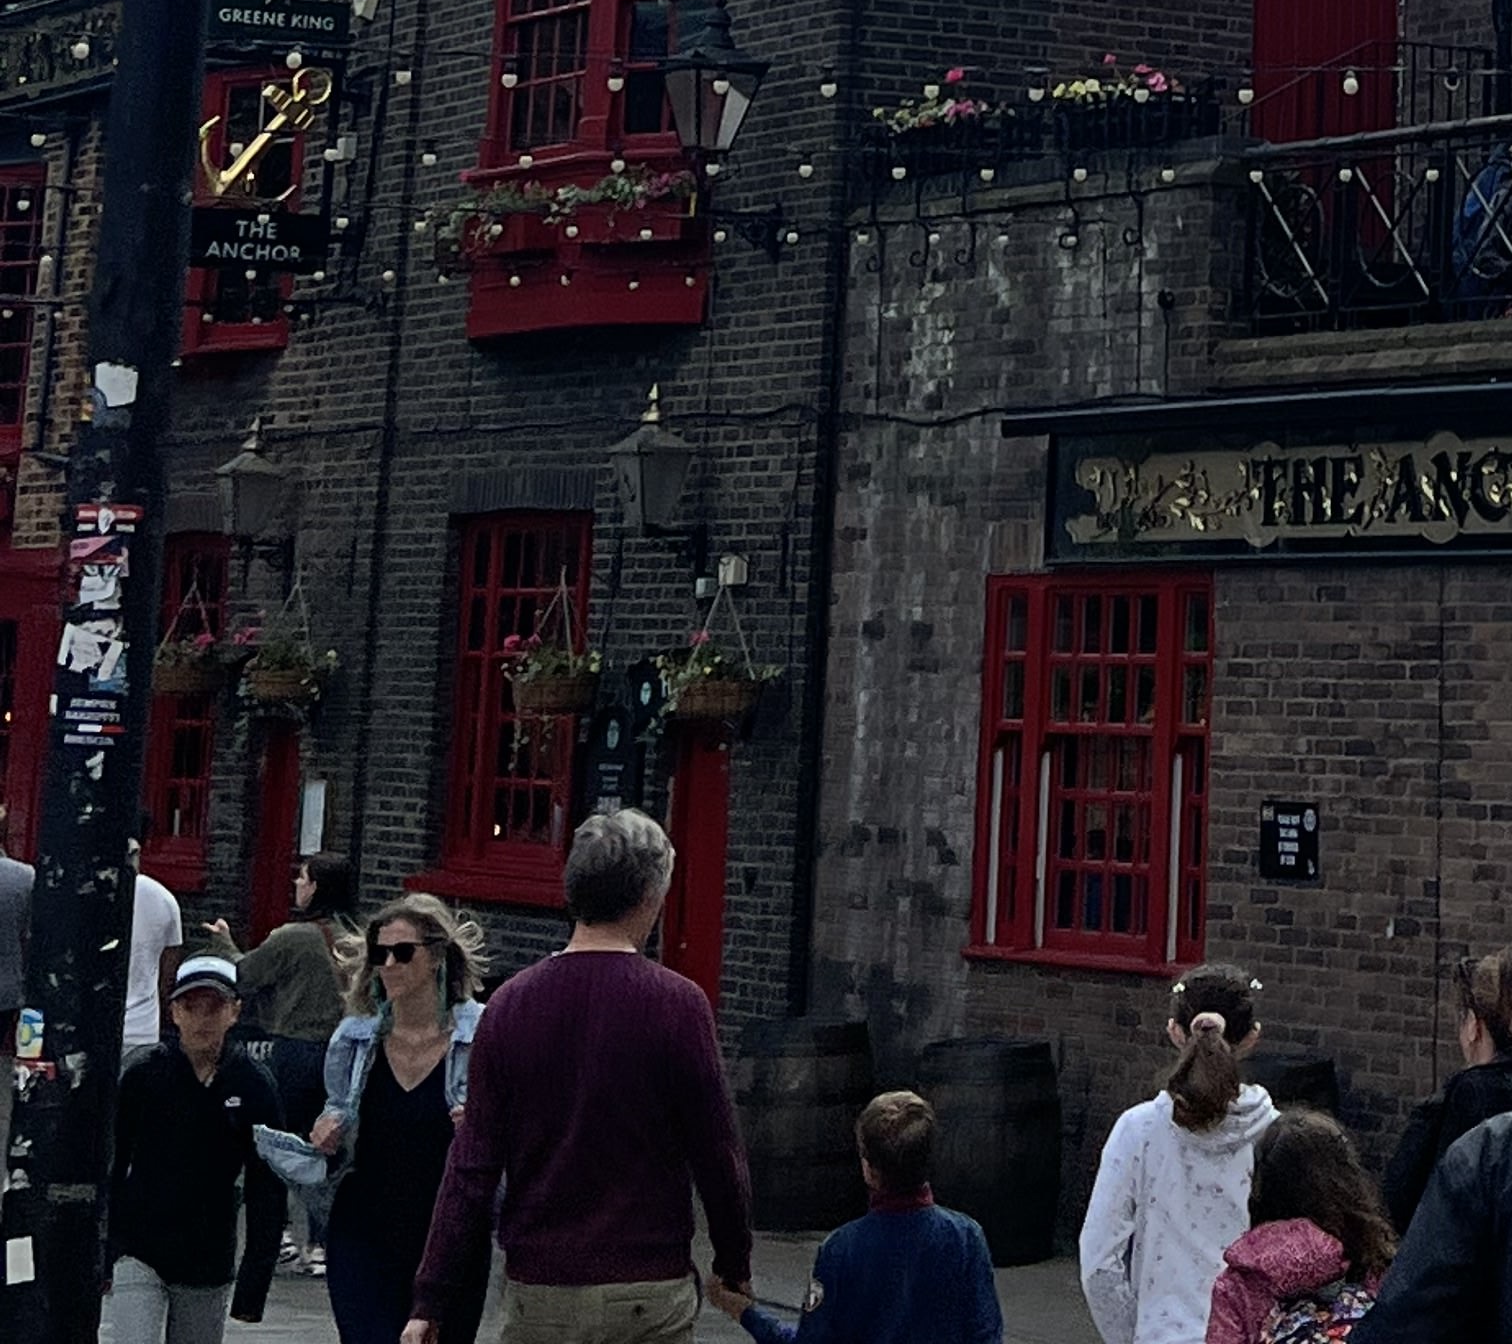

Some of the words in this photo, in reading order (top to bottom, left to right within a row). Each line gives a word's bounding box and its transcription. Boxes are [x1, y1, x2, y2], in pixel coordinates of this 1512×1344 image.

[218, 7, 286, 27] GREENE
[290, 13, 335, 31] KING
[235, 219, 278, 239] THE
[204, 240, 303, 262] ANCHOR
[1252, 453, 1365, 526] THE
